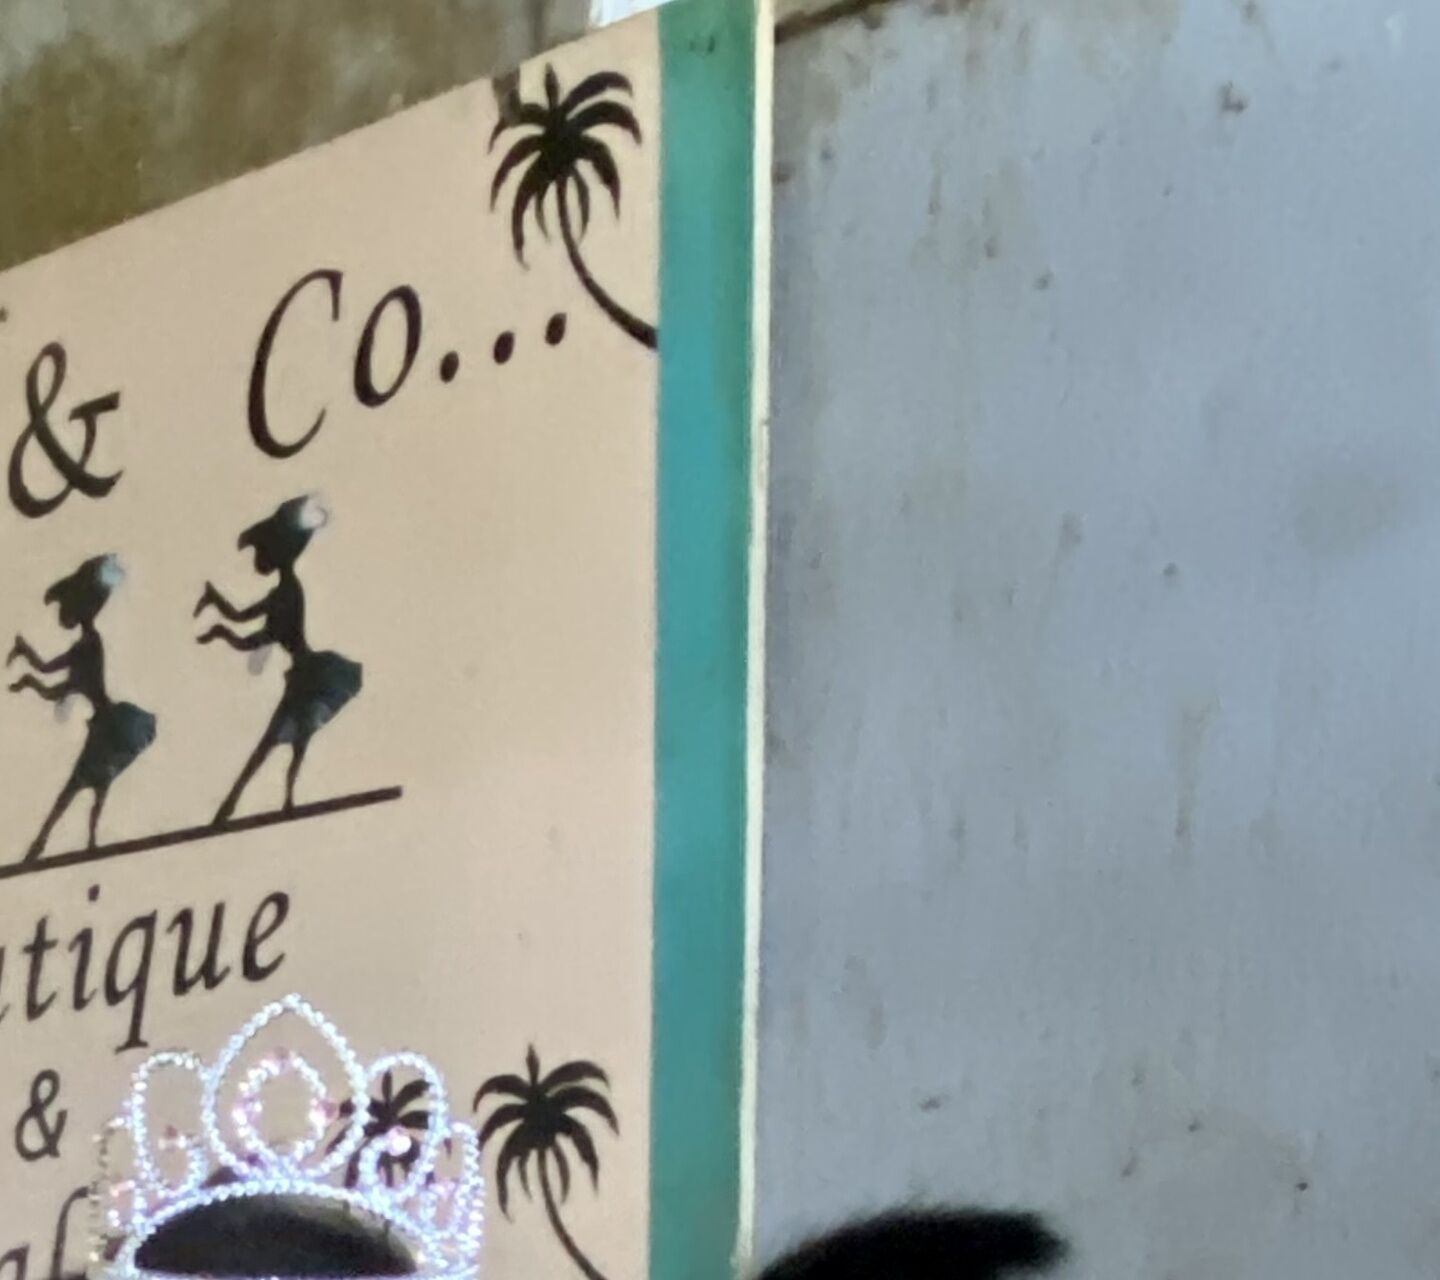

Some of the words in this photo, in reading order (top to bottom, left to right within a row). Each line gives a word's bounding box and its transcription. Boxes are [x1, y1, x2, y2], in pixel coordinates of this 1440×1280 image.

[6, 340, 125, 520] &
[244, 267, 569, 461] Co...
[13, 1067, 69, 1163] &
